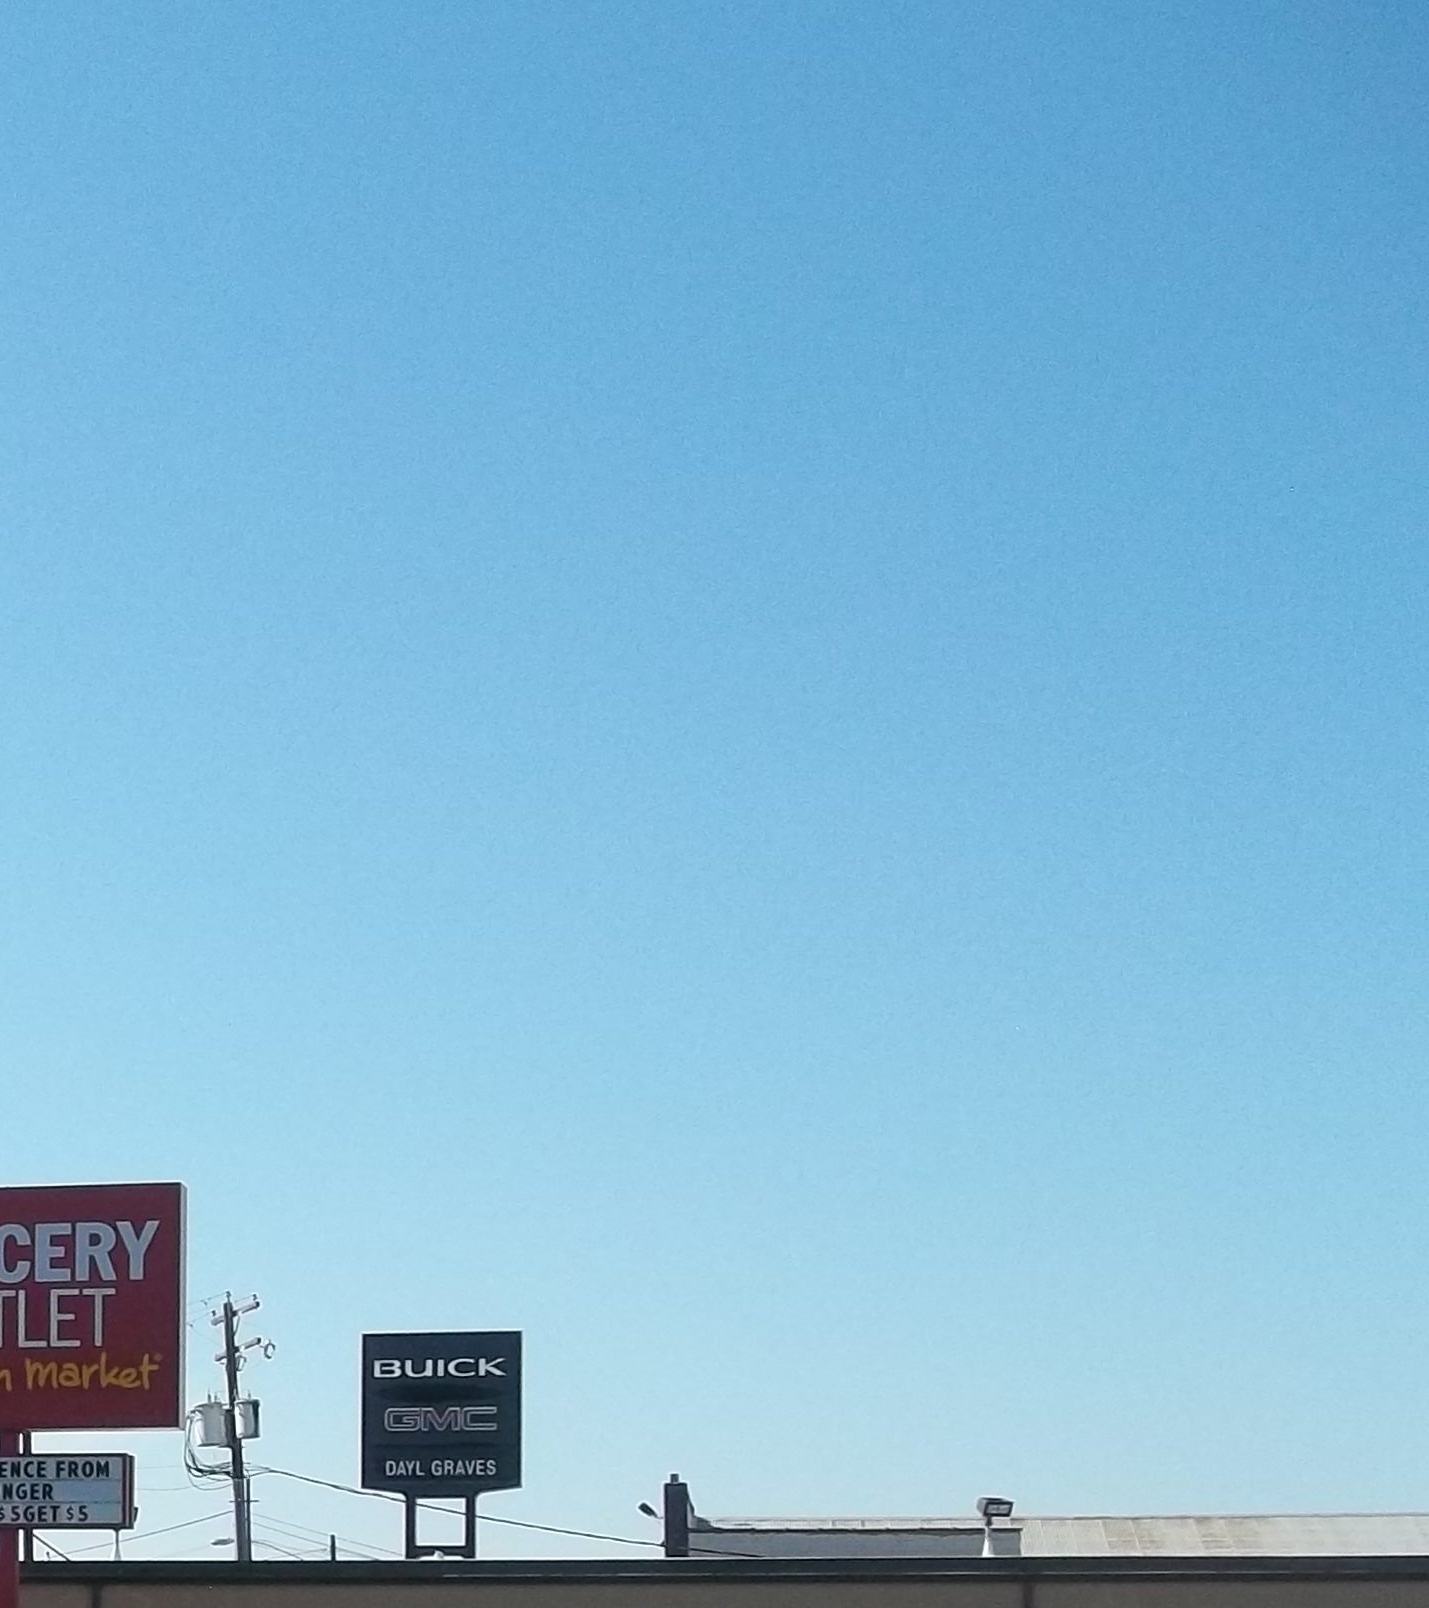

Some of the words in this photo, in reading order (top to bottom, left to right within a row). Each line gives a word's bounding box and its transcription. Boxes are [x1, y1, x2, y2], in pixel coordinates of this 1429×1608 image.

[24, 1352, 160, 1390] market
[373, 1358, 507, 1378] BUICK
[384, 1406, 498, 1431] GMC
[55, 1461, 110, 1478] FROM
[385, 1460, 426, 1476] DAYL
[431, 1460, 497, 1476] GRAVES
[67, 1505, 89, 1522] $5
